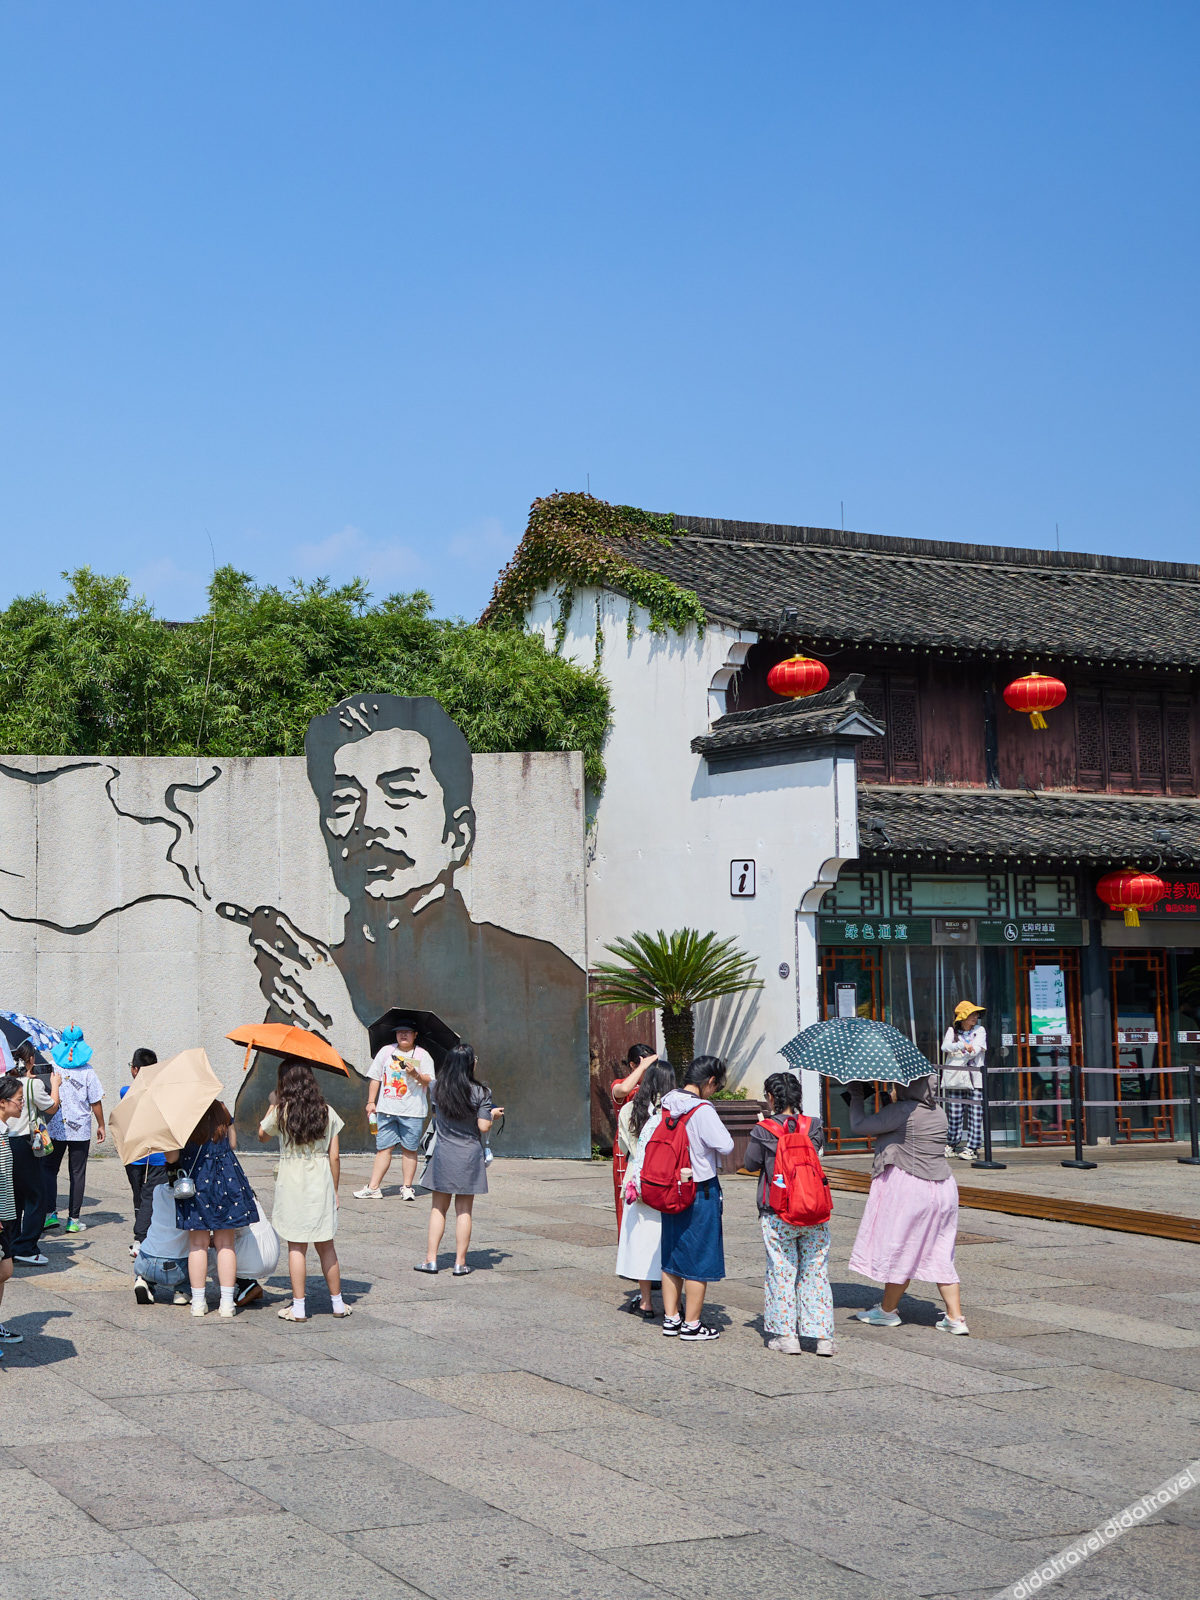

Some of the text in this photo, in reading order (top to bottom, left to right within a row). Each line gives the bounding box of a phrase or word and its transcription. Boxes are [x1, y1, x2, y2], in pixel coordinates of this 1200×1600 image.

[844, 923, 908, 940] 绿色通道
[1021, 922, 1056, 932] 无障碍通道
